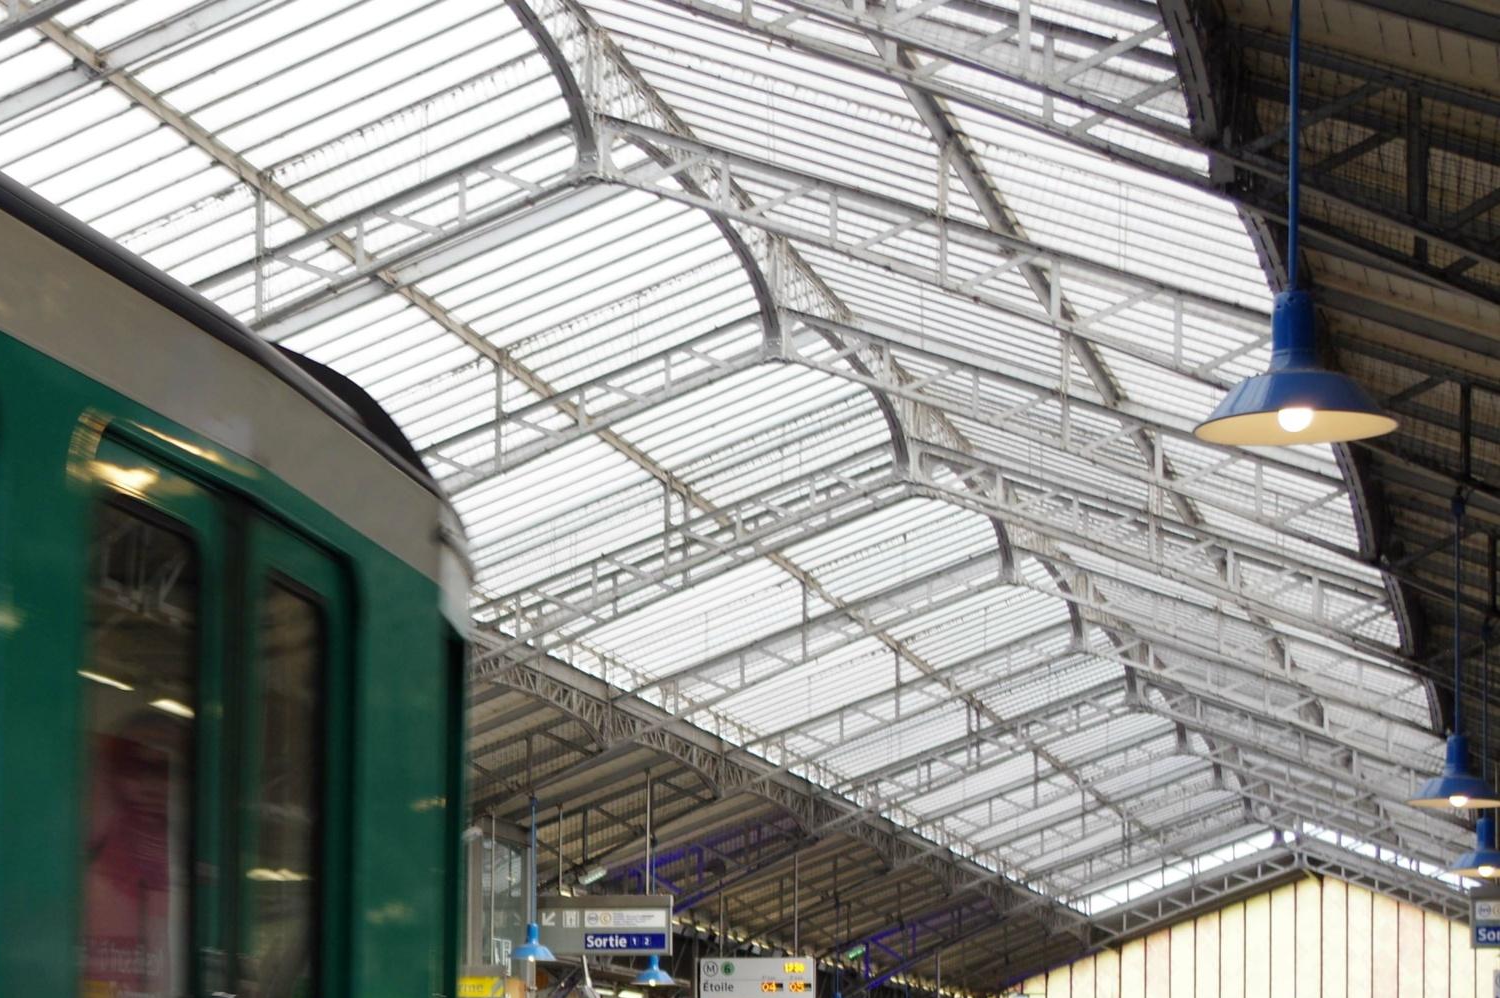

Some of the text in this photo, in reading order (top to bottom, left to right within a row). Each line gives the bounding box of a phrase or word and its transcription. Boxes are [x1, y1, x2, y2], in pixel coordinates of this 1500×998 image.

[586, 934, 650, 948] Sortie 1 2
[703, 980, 734, 992] Étoile
